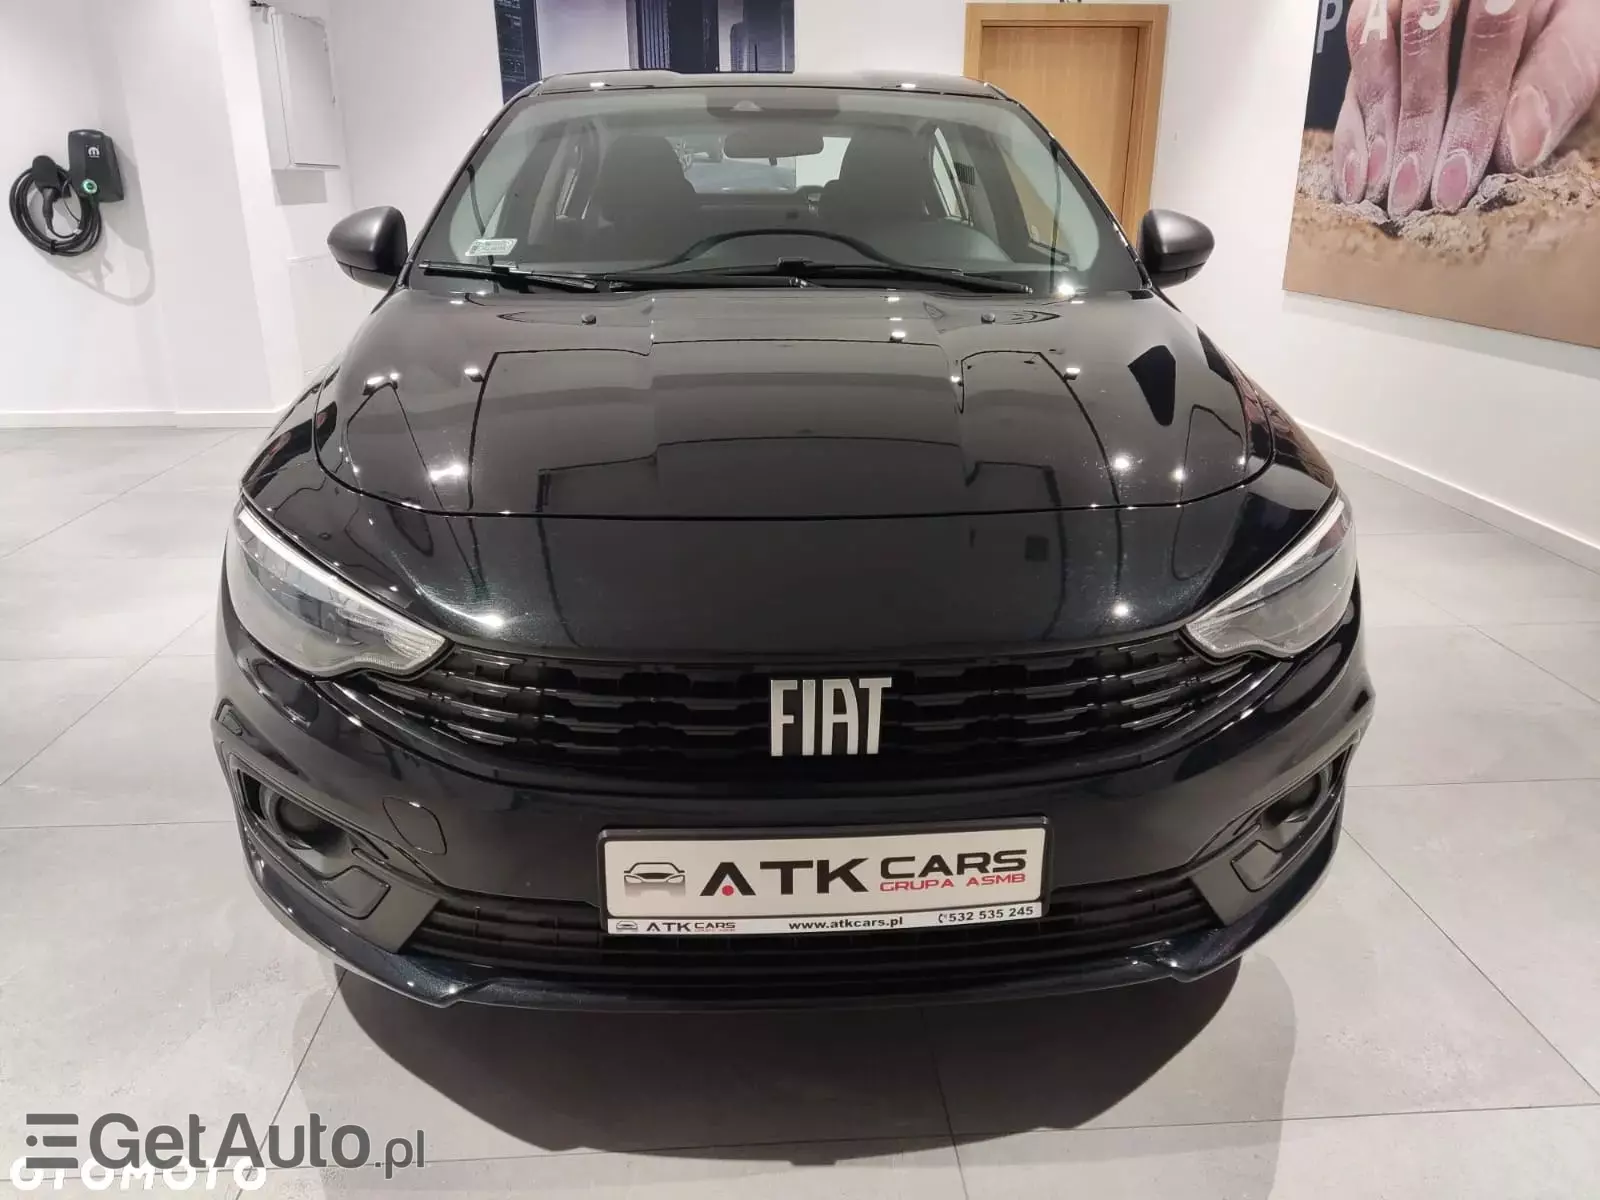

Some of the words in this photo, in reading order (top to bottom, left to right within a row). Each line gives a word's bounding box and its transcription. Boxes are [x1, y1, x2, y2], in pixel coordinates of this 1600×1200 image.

[770, 677, 892, 757] FIAT
[699, 857, 869, 896] ATK
[880, 849, 1027, 879] CARS
[879, 879, 954, 892] GRUPA
[966, 873, 1026, 887] ASMB
[949, 911, 974, 922] 532
[979, 909, 1004, 920] 535
[1008, 906, 1034, 917] 245
[646, 922, 691, 932] ATK
[788, 916, 903, 930] www.atkcars.pl
